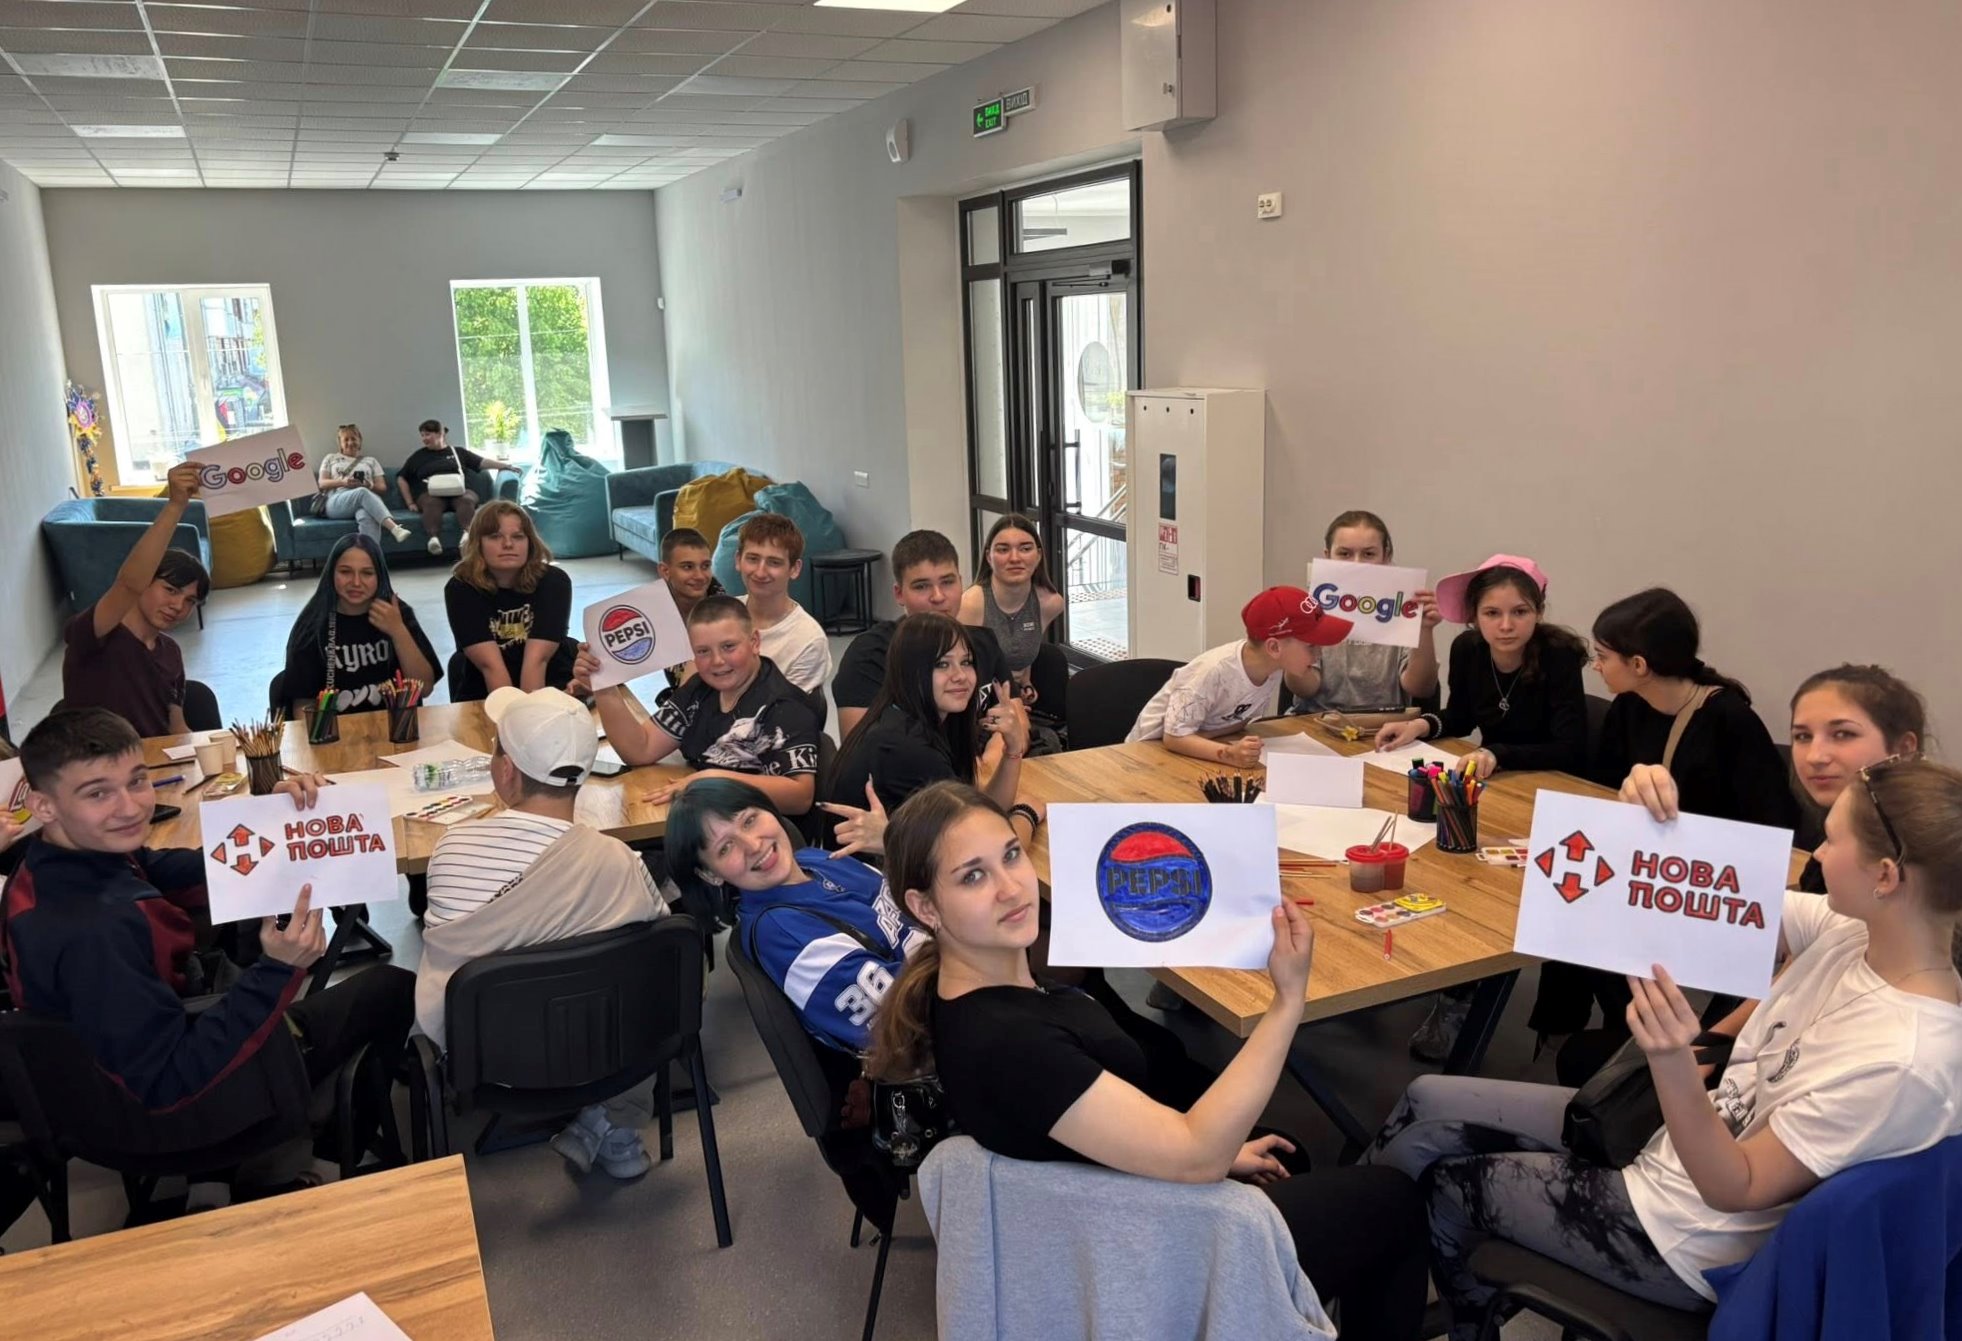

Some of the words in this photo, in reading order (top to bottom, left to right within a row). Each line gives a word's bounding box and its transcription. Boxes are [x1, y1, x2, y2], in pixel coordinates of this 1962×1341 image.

[200, 447, 305, 490] Google
[1312, 582, 1419, 623] Google
[604, 621, 650, 648] PEPSI
[284, 813, 363, 841] НОВА
[286, 834, 386, 862] ПОШТА
[1106, 867, 1201, 897] PEPSI
[1631, 850, 1740, 894] НОВА
[1628, 880, 1766, 930] ПОШТА
[834, 960, 895, 1027] 36
